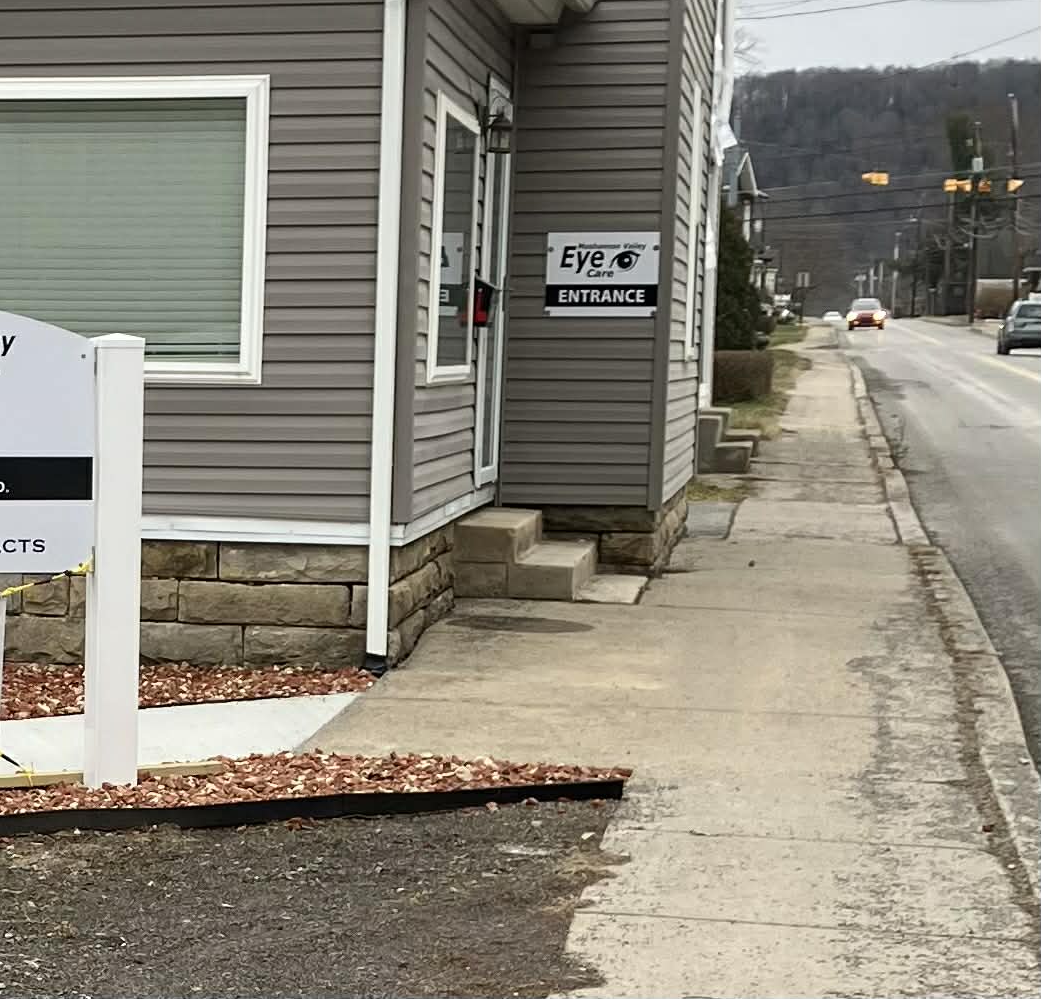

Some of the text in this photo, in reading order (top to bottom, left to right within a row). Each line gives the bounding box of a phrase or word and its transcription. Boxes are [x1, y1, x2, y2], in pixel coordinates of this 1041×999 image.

[560, 245, 605, 274] Eye
[586, 268, 614, 278] Care
[558, 289, 645, 303] ENTRANCE
